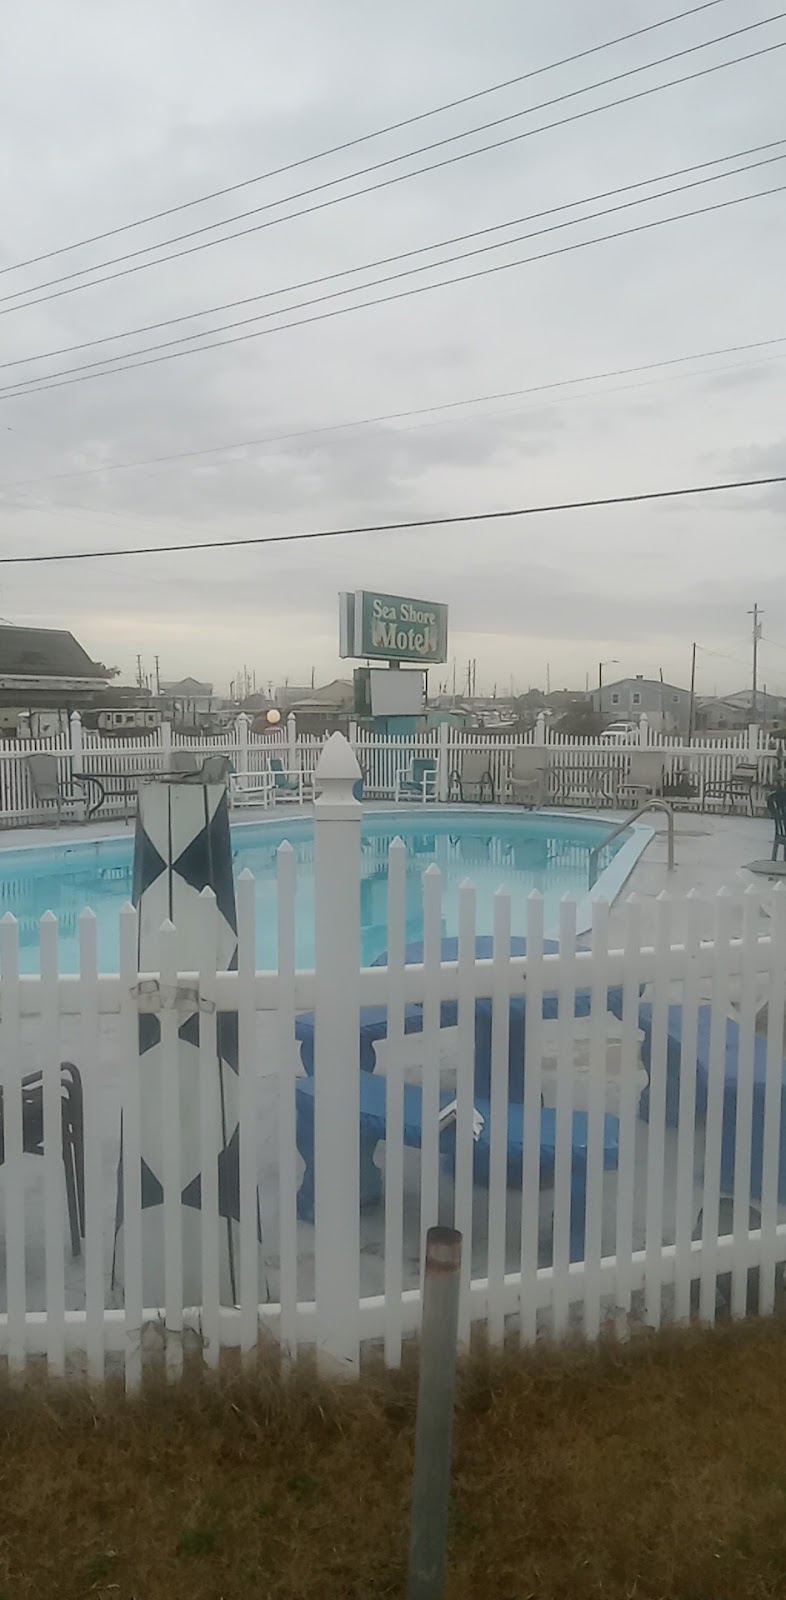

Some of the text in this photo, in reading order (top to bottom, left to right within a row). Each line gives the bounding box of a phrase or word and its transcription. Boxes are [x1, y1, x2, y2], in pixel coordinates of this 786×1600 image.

[373, 599, 436, 625] Sea Shore
[376, 621, 432, 652] Motel
